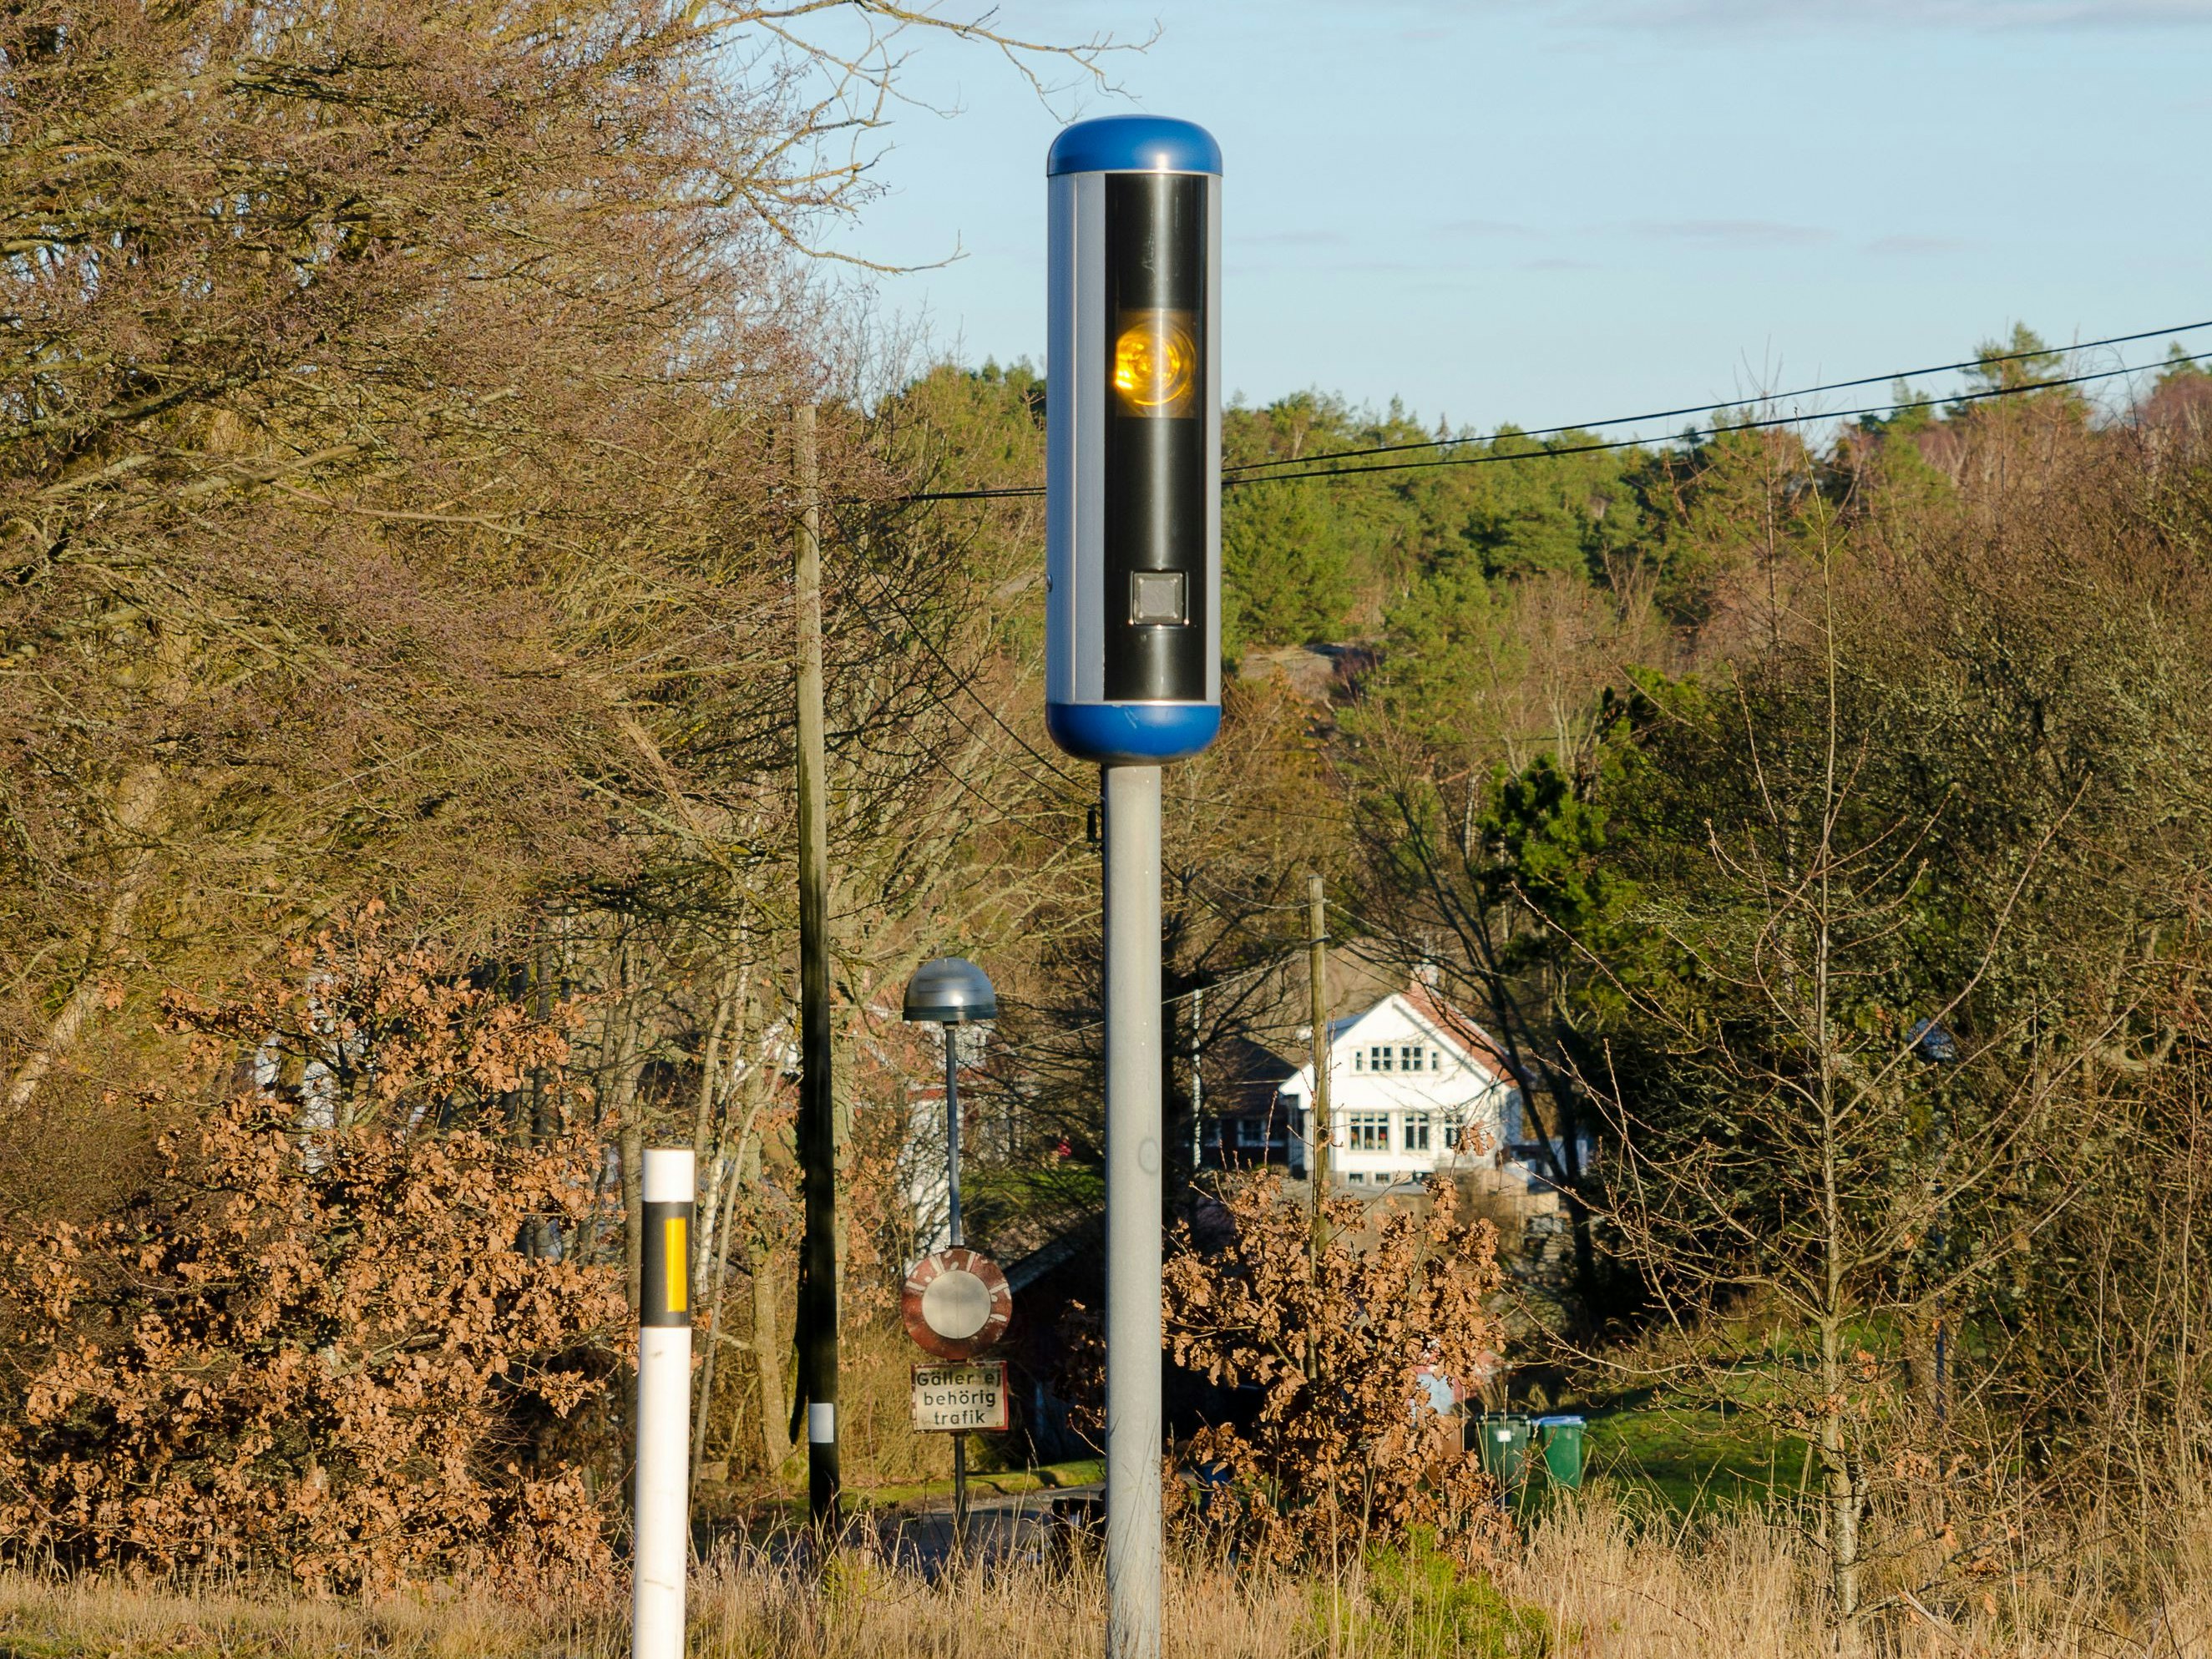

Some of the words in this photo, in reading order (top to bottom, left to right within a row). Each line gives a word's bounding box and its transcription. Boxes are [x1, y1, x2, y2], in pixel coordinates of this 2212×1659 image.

[917, 1371, 974, 1386] Gäller
[985, 1370, 1001, 1387] ej
[924, 1389, 996, 1407] behörig
[934, 1409, 986, 1424] trafik
